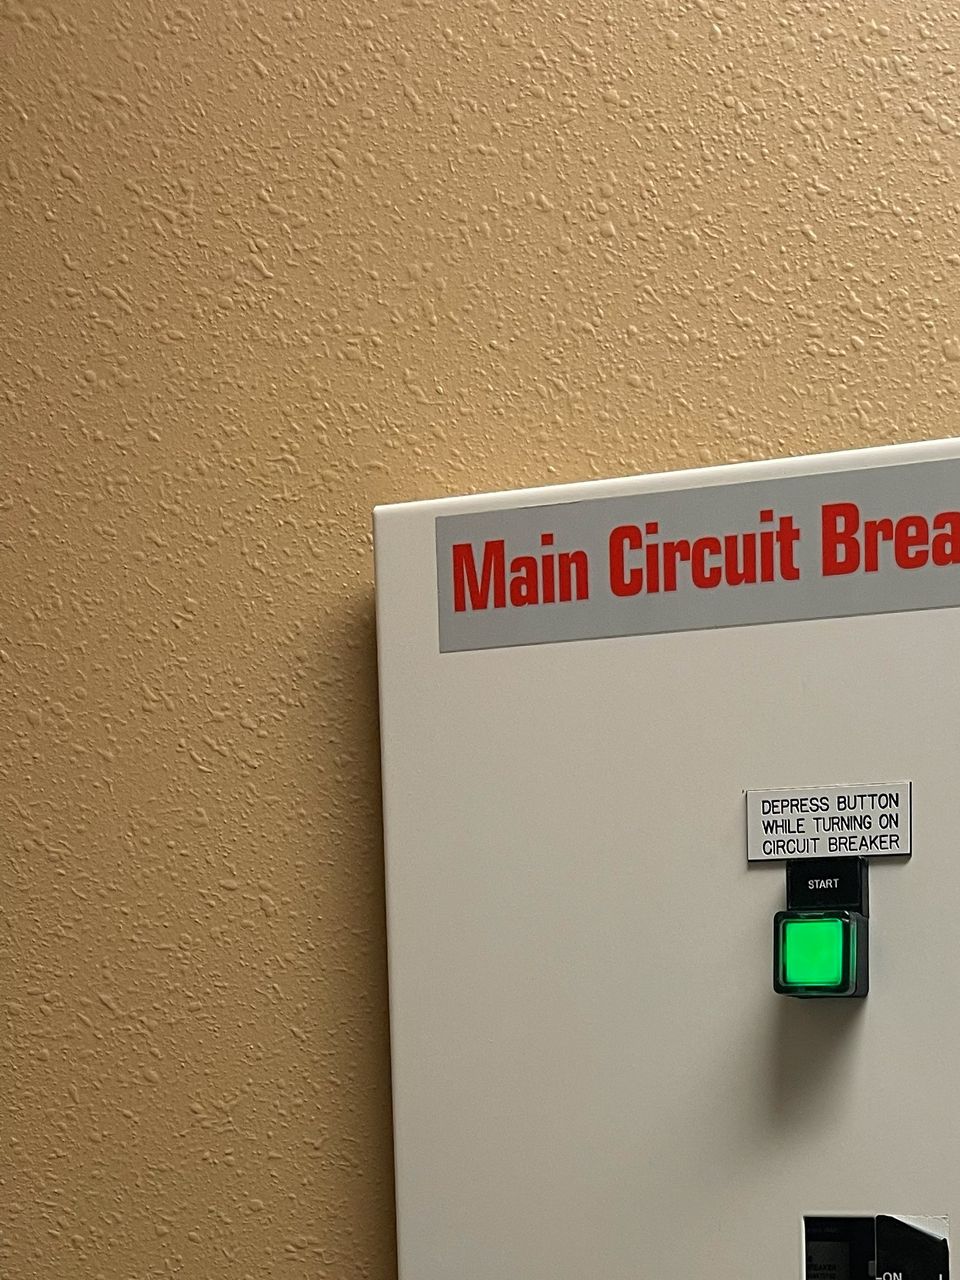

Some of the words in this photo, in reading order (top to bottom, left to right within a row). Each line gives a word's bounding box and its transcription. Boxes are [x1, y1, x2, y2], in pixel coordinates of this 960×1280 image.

[452, 533, 590, 613] Main
[608, 510, 801, 597] Circuit
[761, 797, 830, 815] DEPRESS
[837, 793, 899, 811] BUTTON
[762, 818, 805, 835] WHILE
[813, 815, 872, 832] TURNING
[879, 813, 899, 829] ON
[762, 838, 820, 855] CIRCUIT
[828, 834, 900, 852] BREAKER
[808, 878, 839, 889] START
